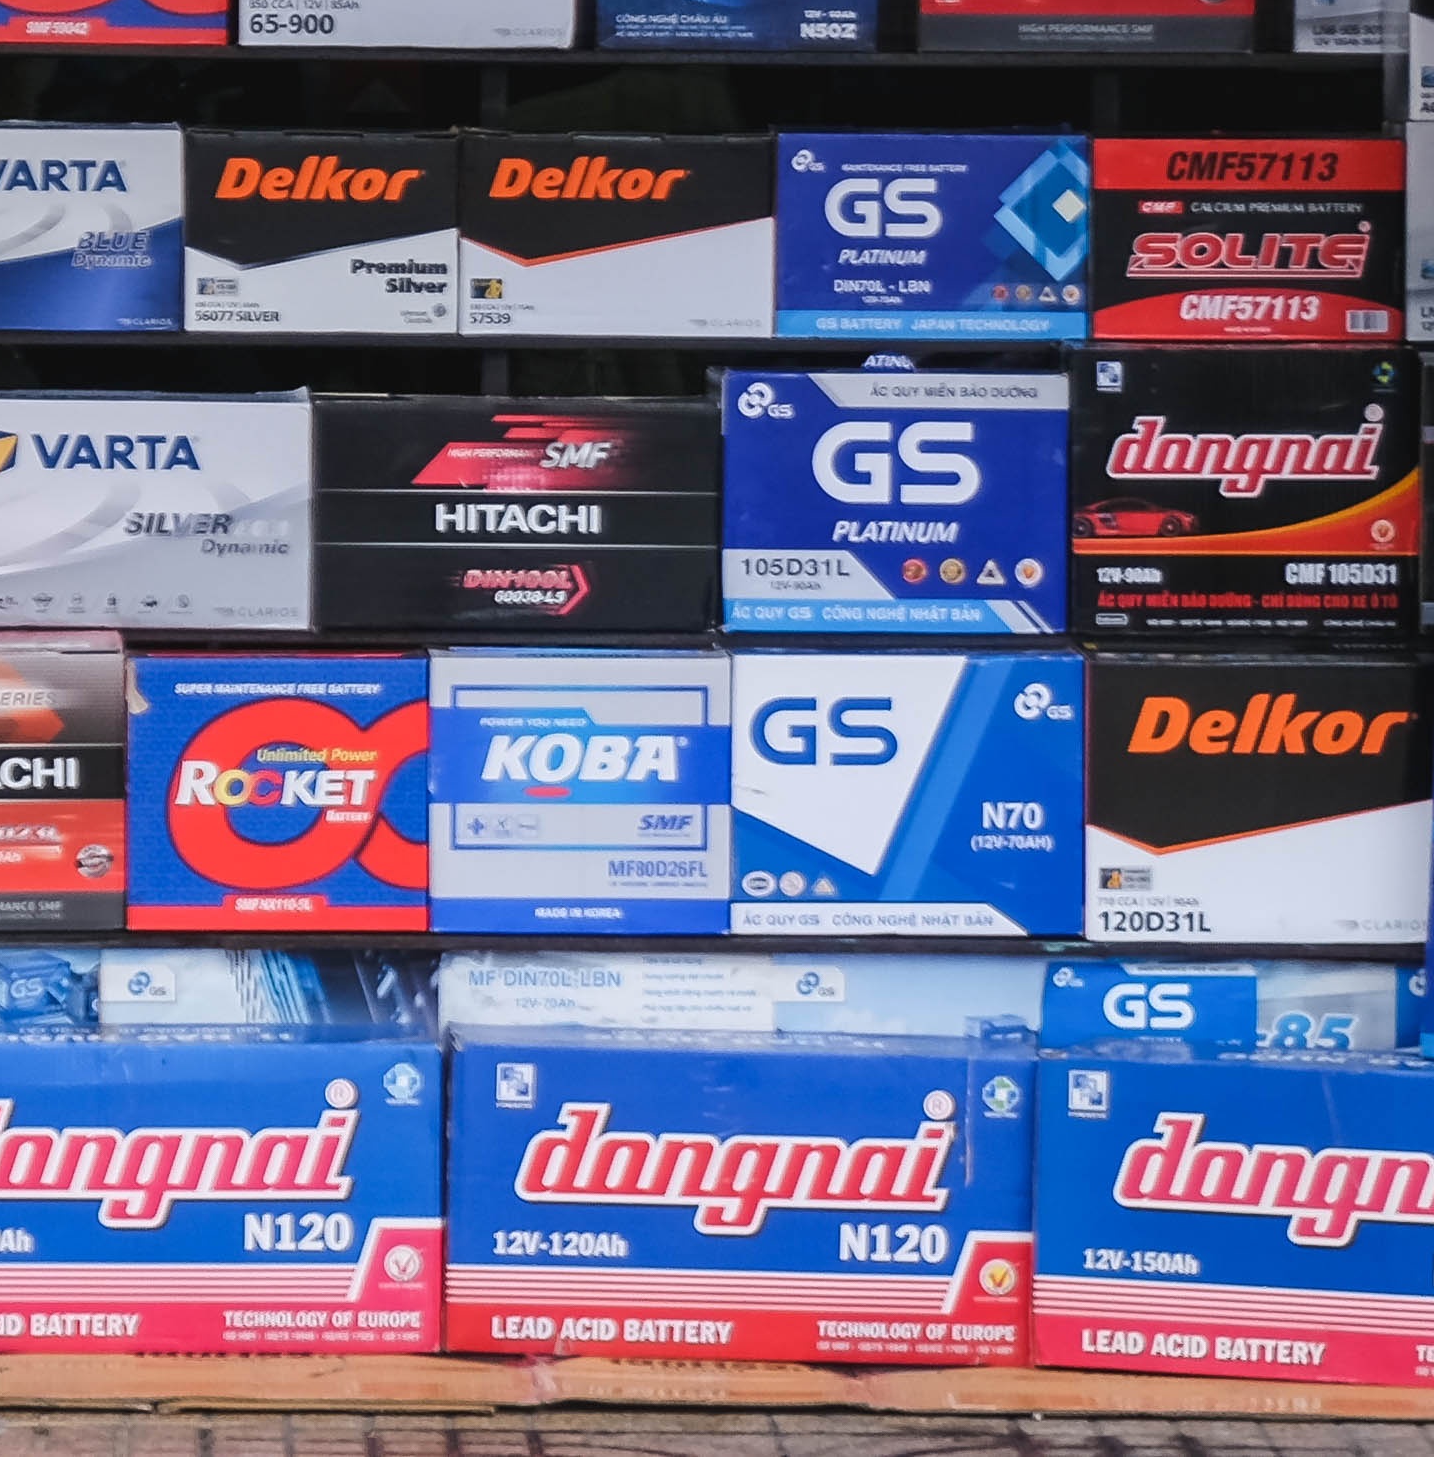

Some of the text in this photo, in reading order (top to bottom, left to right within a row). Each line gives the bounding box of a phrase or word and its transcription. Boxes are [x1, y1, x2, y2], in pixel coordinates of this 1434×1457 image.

[250, 13, 333, 36] 65-900
[1166, 151, 1338, 183] CMF57113
[1191, 201, 1363, 214] CALCIUM PREMIUM BATTERY
[77, 231, 147, 253] BLUE
[1126, 230, 1371, 278] SOLITE
[71, 251, 152, 270] Dynamic
[31, 433, 201, 472] VARTA
[811, 420, 982, 507] GS
[122, 511, 232, 539] SILVER
[200, 538, 290, 557] Dynamic
[741, 558, 849, 578] 105D31L
[480, 732, 680, 784] KOBA
[982, 801, 1043, 829] N70
[608, 859, 708, 878] MF80D26FL
[832, 913, 994, 928] CÔNG NGHỆ NHẬT BẢN
[1098, 911, 1211, 934] 120D31L
[244, 1213, 352, 1253] N120
[1083, 1248, 1199, 1276] 12V-150Ah
[32, 1313, 140, 1338] BATTERY
[223, 1311, 421, 1328] TECHNOLOGY OF EUROPE
[1082, 1328, 1325, 1366] LEAD ACID BATTERY
